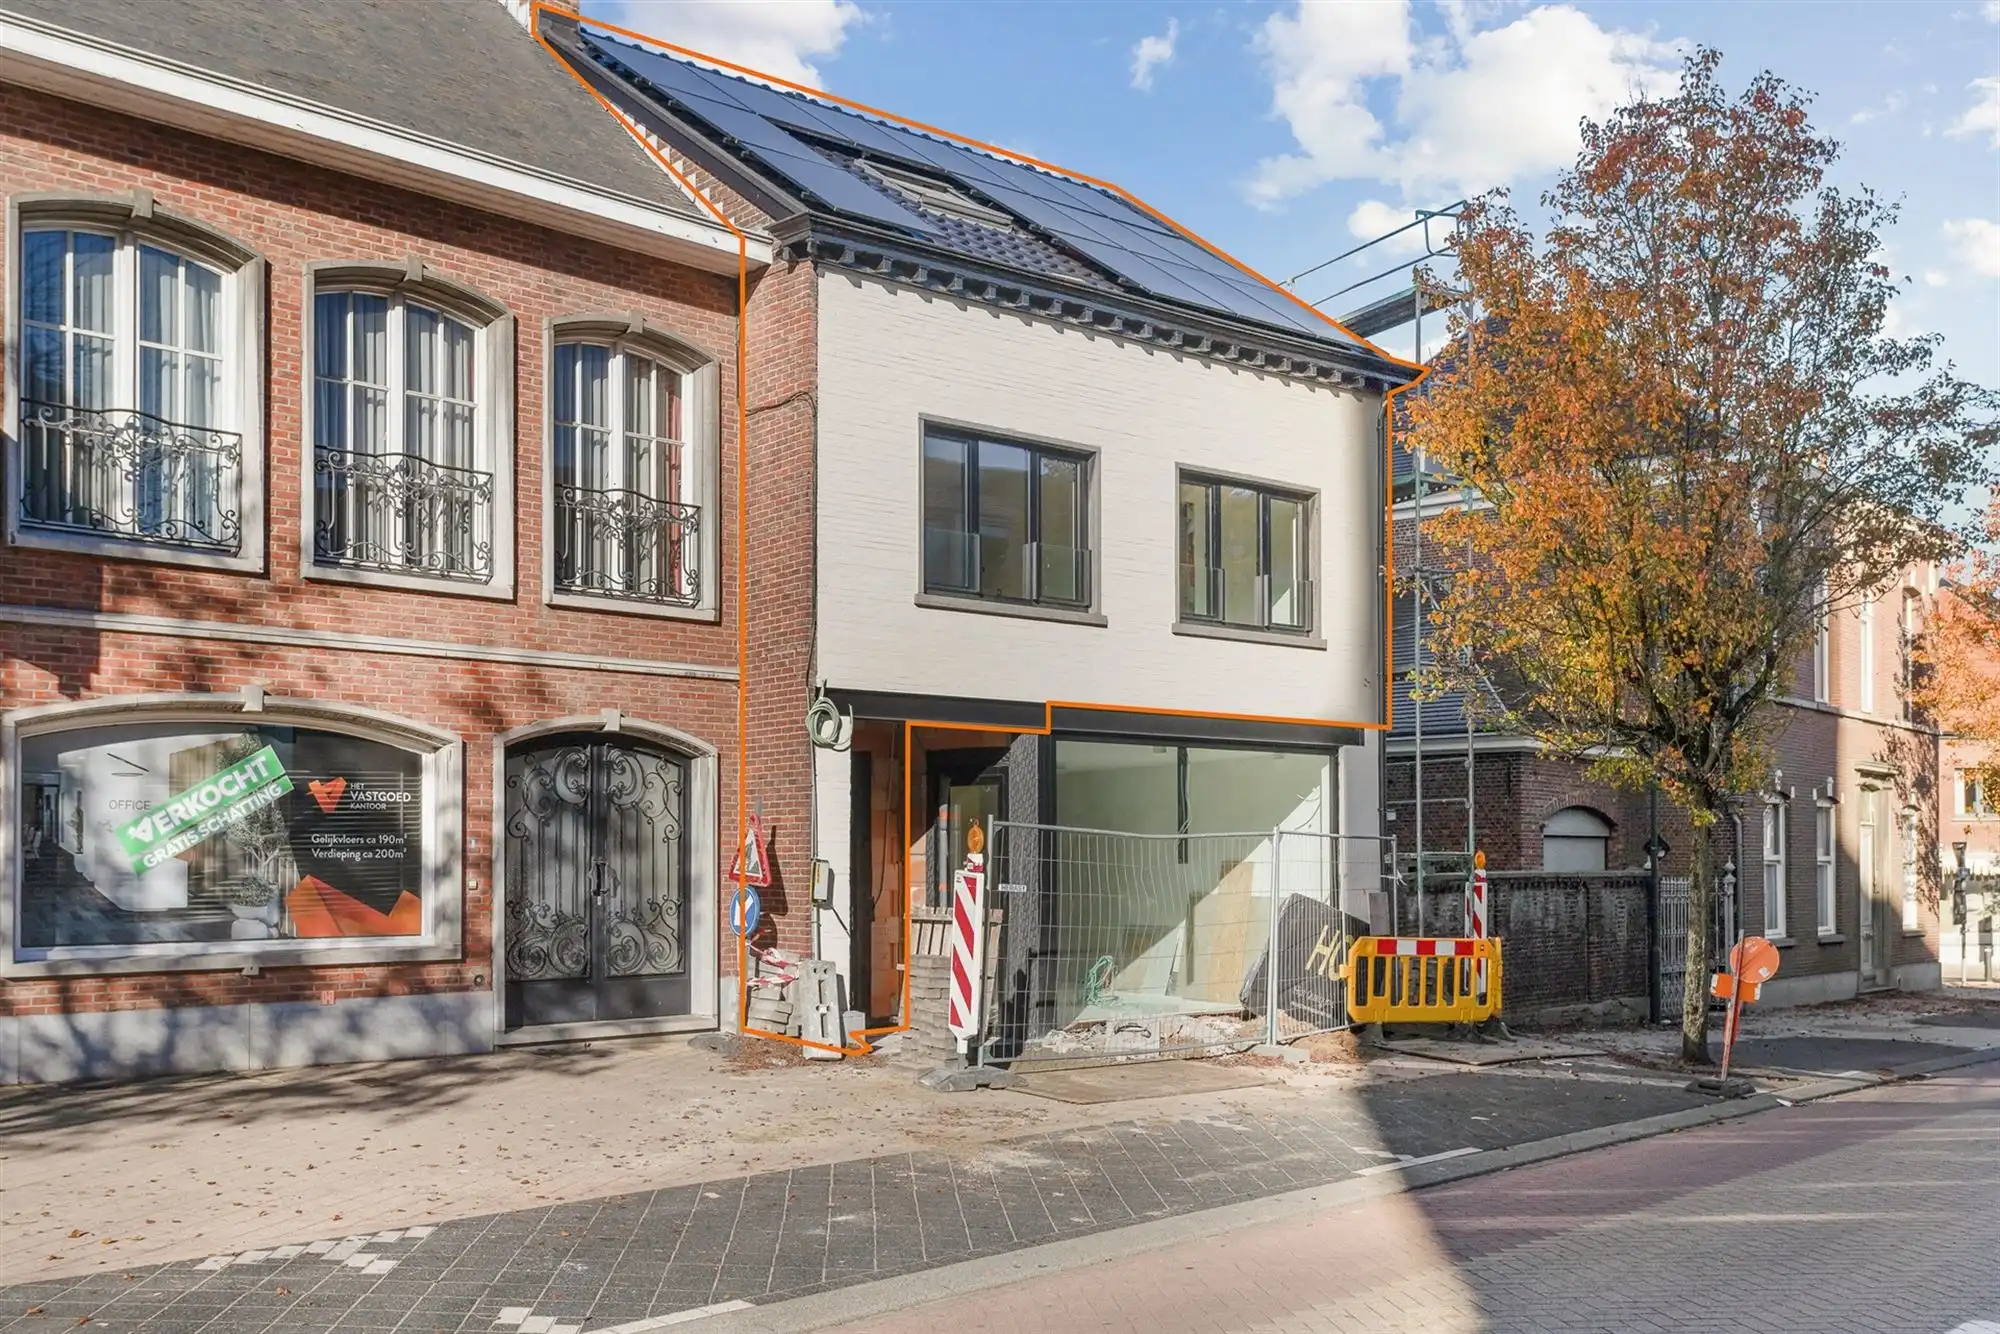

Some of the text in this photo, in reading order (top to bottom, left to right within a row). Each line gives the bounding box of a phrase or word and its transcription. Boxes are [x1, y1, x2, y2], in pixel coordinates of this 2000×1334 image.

[127, 756, 271, 843] VERKOCHT
[350, 791, 412, 802] VASTGOED
[109, 799, 151, 810] OFFICE
[143, 783, 282, 868] GRATIS SCHATTING
[311, 833, 365, 847] Gelijkvloers
[311, 848, 361, 862] Verdieping
